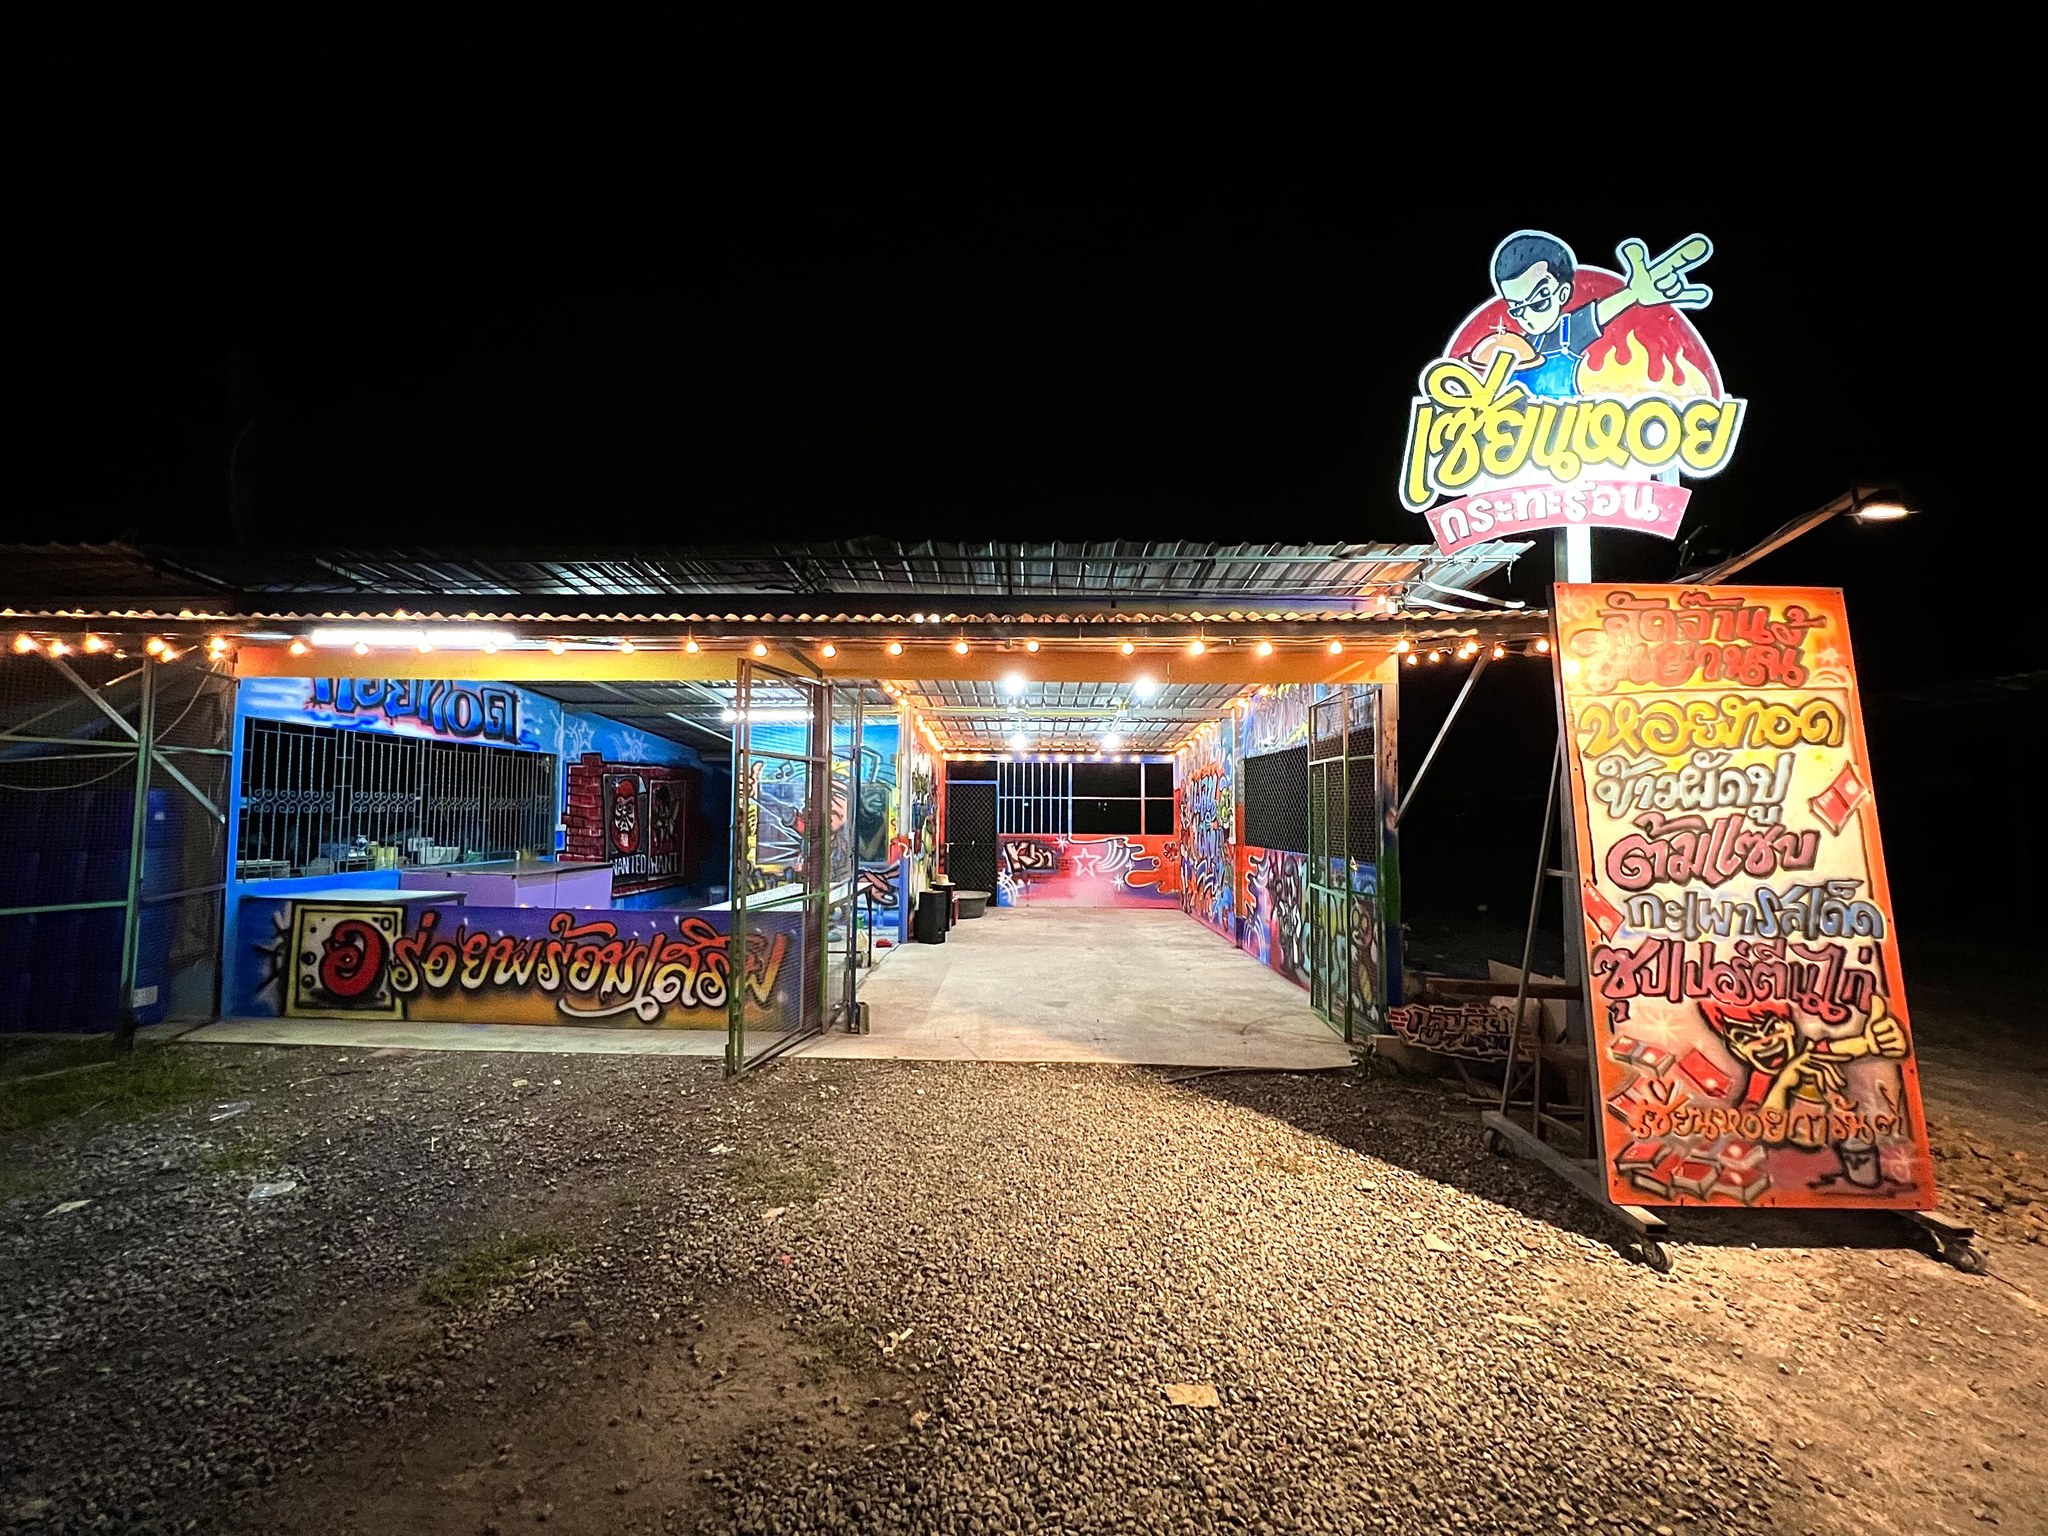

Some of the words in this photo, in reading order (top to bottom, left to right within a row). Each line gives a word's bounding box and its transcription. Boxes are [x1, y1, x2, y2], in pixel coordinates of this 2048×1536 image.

[1577, 694, 1846, 759] หอยทอด
[1592, 752, 1796, 826] ข้าวผัดปู
